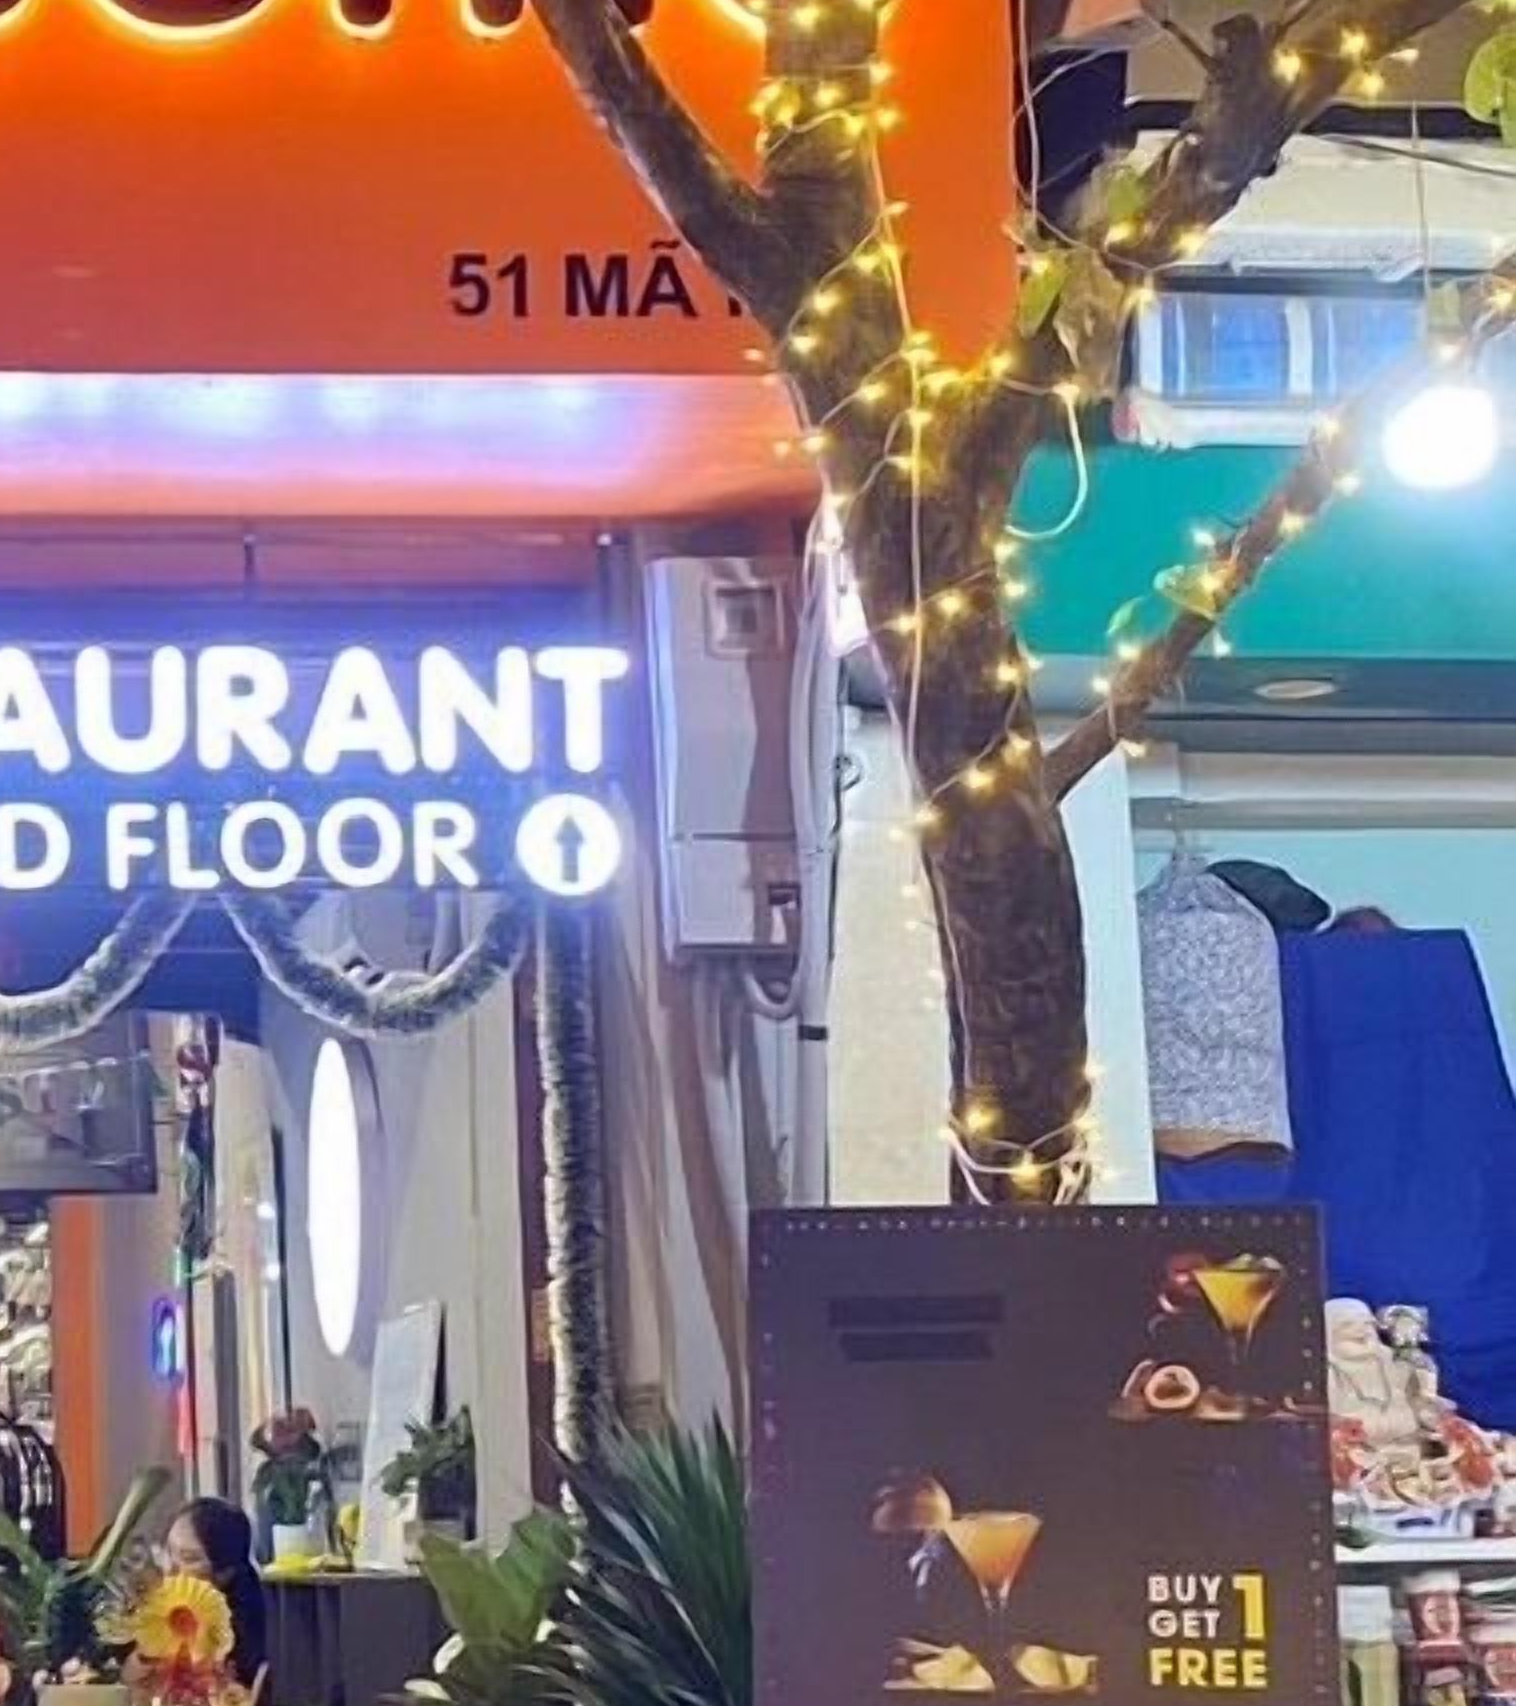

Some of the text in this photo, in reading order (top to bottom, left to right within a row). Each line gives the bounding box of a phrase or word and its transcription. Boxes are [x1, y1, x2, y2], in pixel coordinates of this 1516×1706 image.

[450, 240, 697, 317] 51 MÃ
[106, 798, 480, 891] FLOOR
[1148, 1572, 1264, 1640] BUY 1
[1148, 1609, 1220, 1639] GET
[1149, 1647, 1268, 1688] FREE
